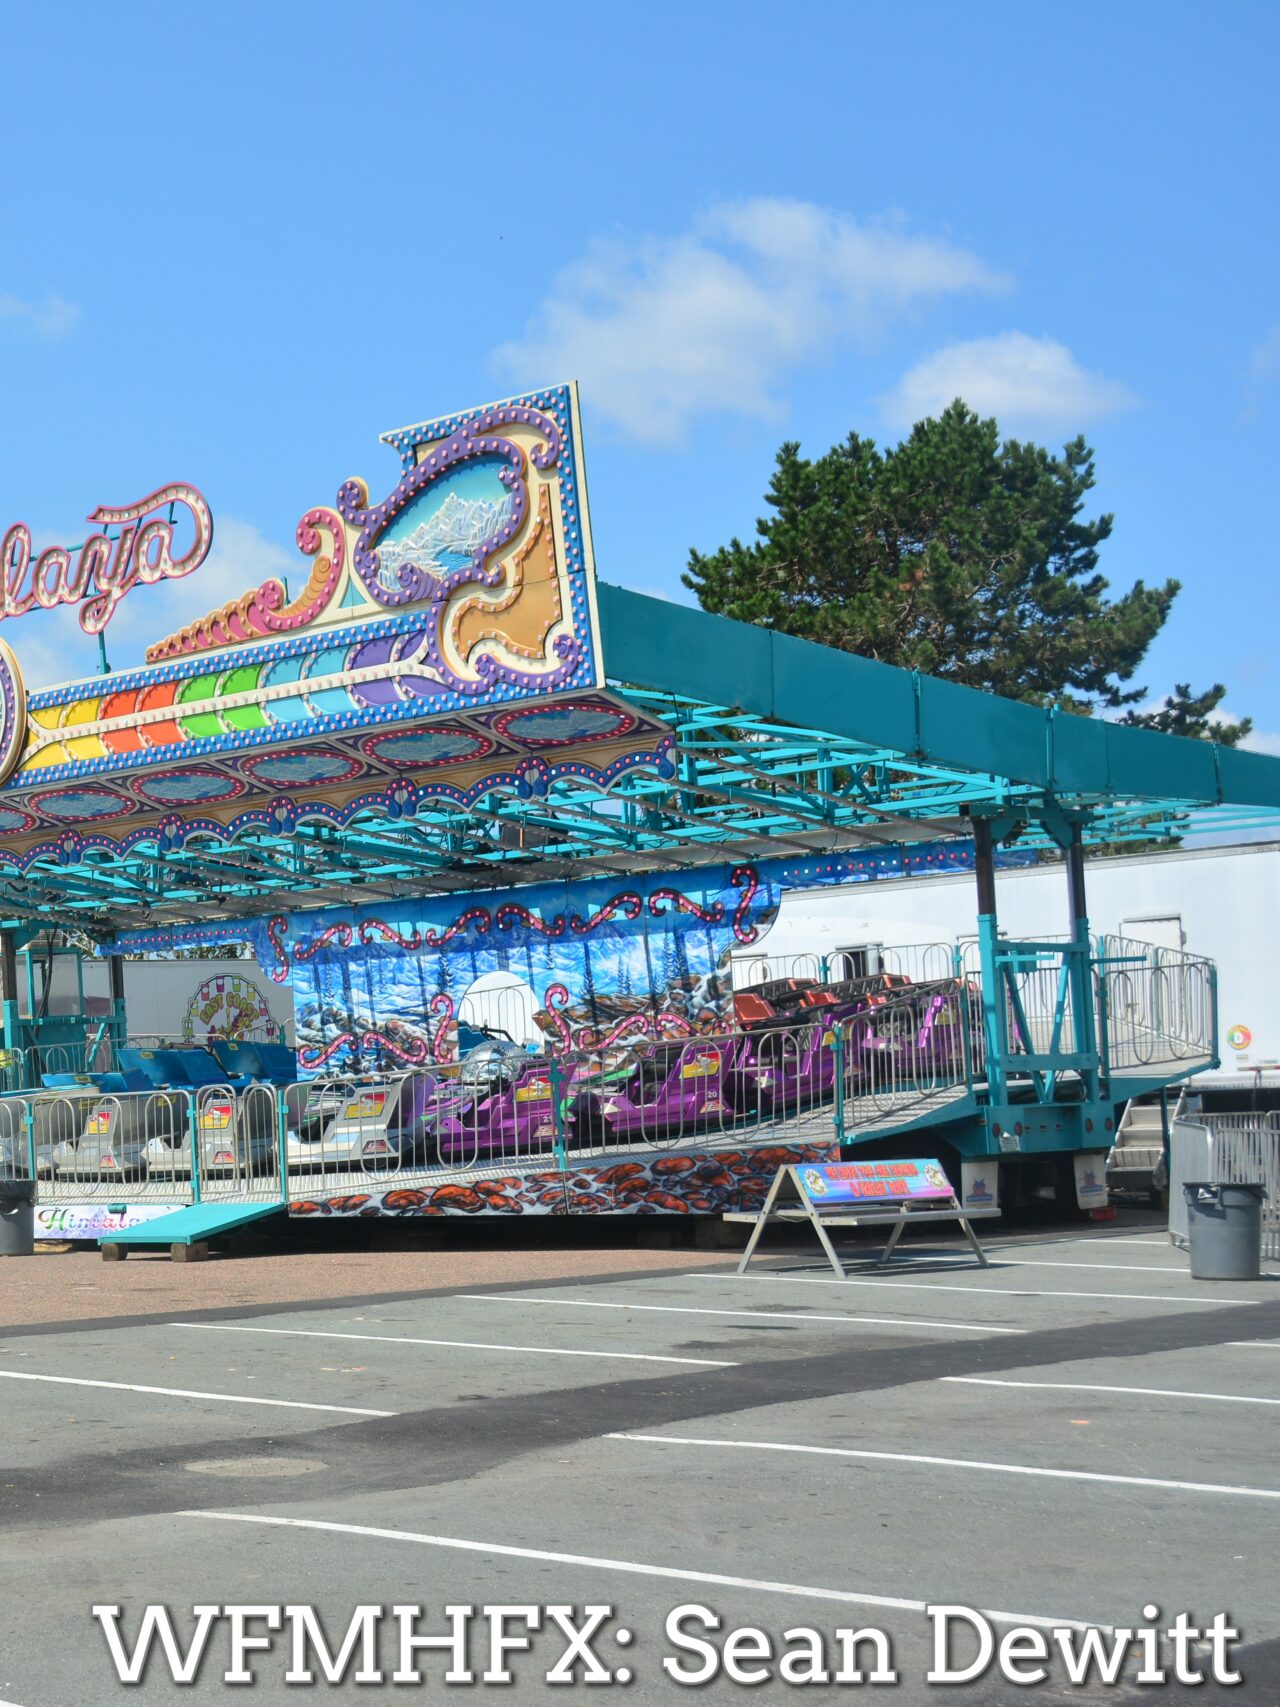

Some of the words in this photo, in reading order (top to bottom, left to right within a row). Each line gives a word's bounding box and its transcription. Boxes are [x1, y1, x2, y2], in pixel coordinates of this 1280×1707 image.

[200, 994, 223, 1025] EAST
[226, 991, 259, 1021] COAST
[824, 1167, 839, 1181] WE
[38, 1207, 153, 1231] Himala
